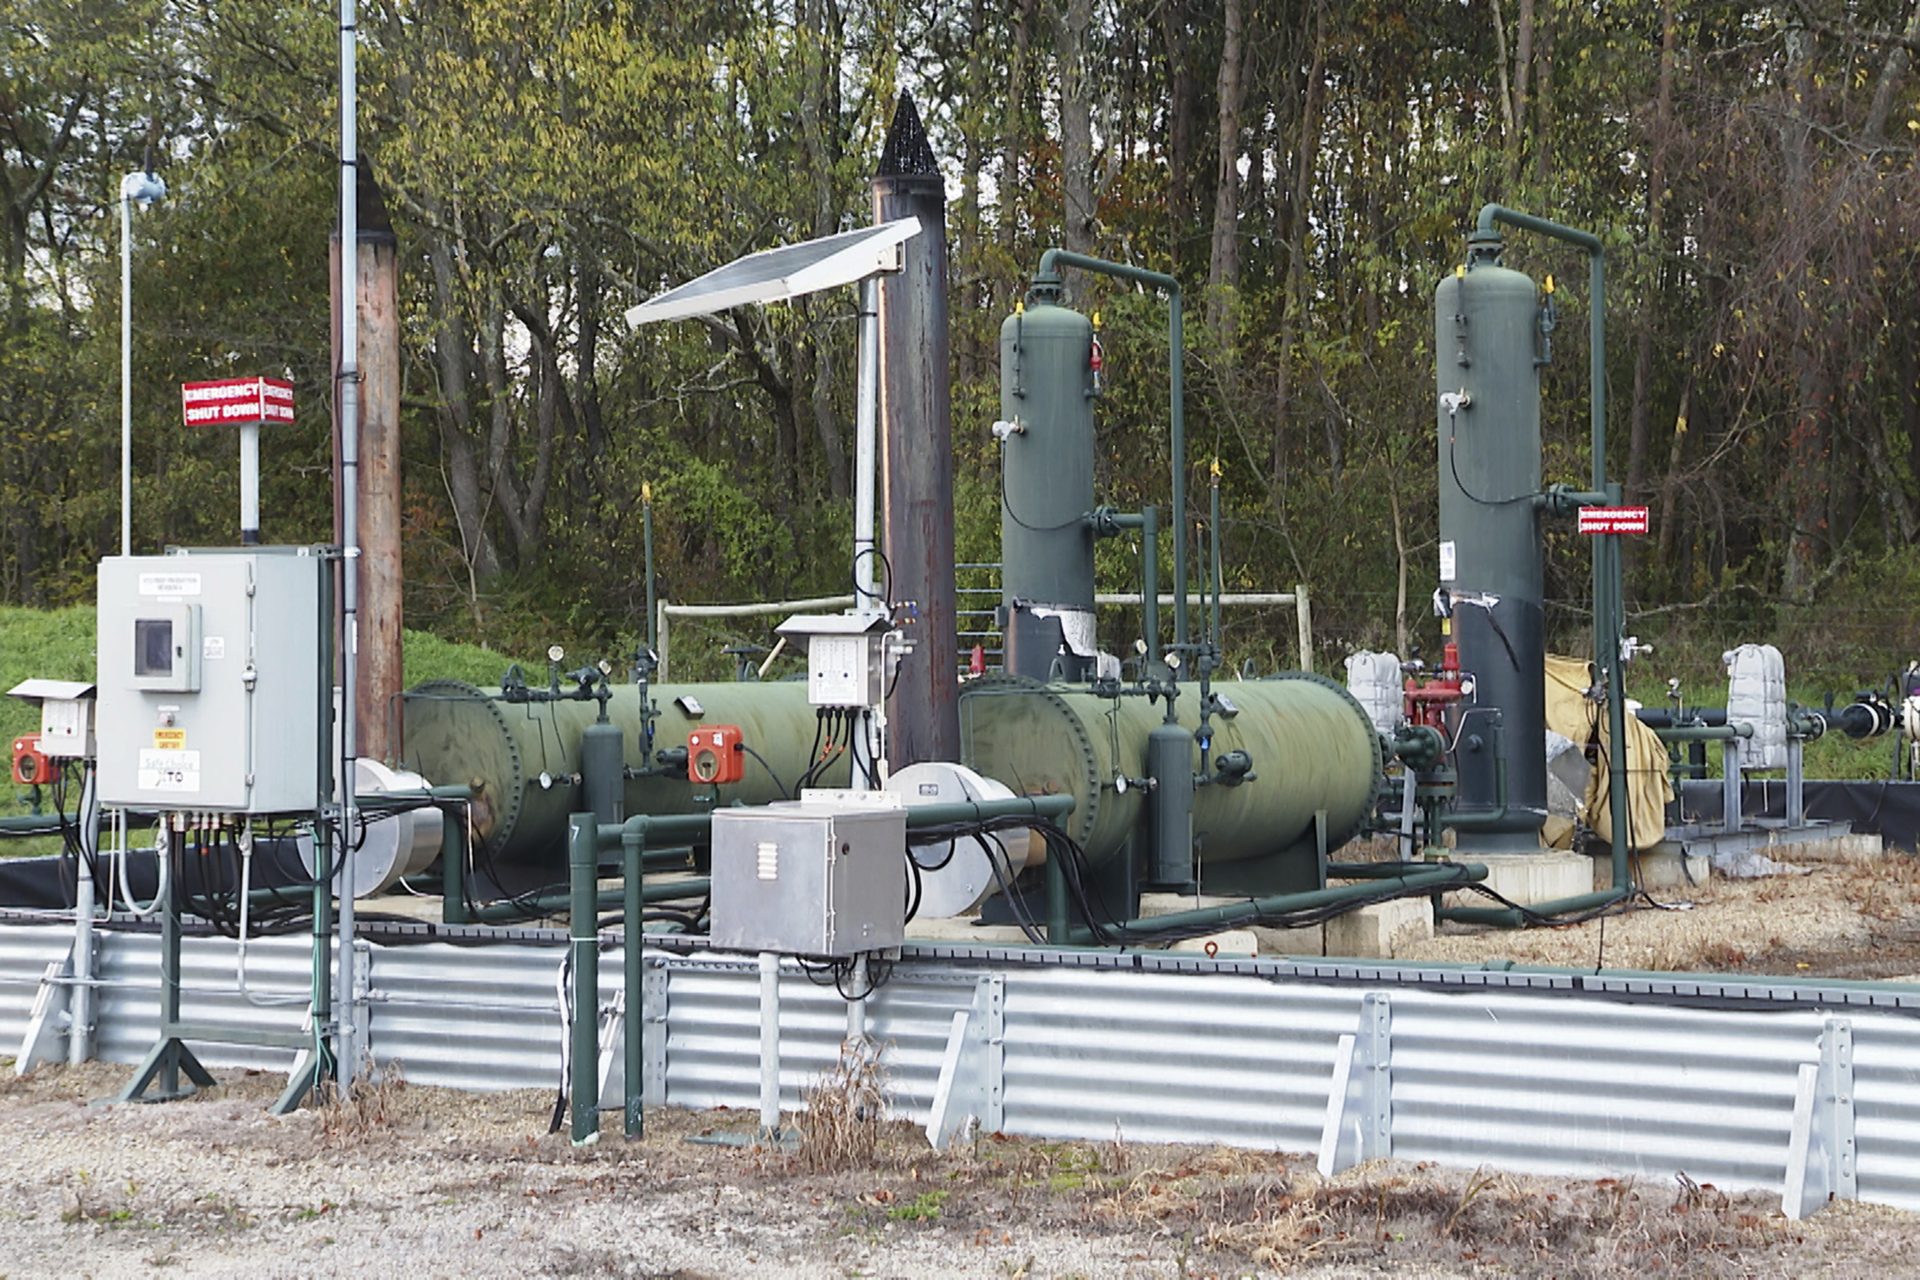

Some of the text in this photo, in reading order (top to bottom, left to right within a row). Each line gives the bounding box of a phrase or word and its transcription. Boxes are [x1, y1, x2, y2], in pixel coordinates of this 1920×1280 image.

[185, 383, 260, 401] EMERGENCY
[187, 403, 259, 421] SHUT DOWN
[1580, 510, 1645, 518] EMERGENCY
[1581, 522, 1645, 531] SHUT DOWN
